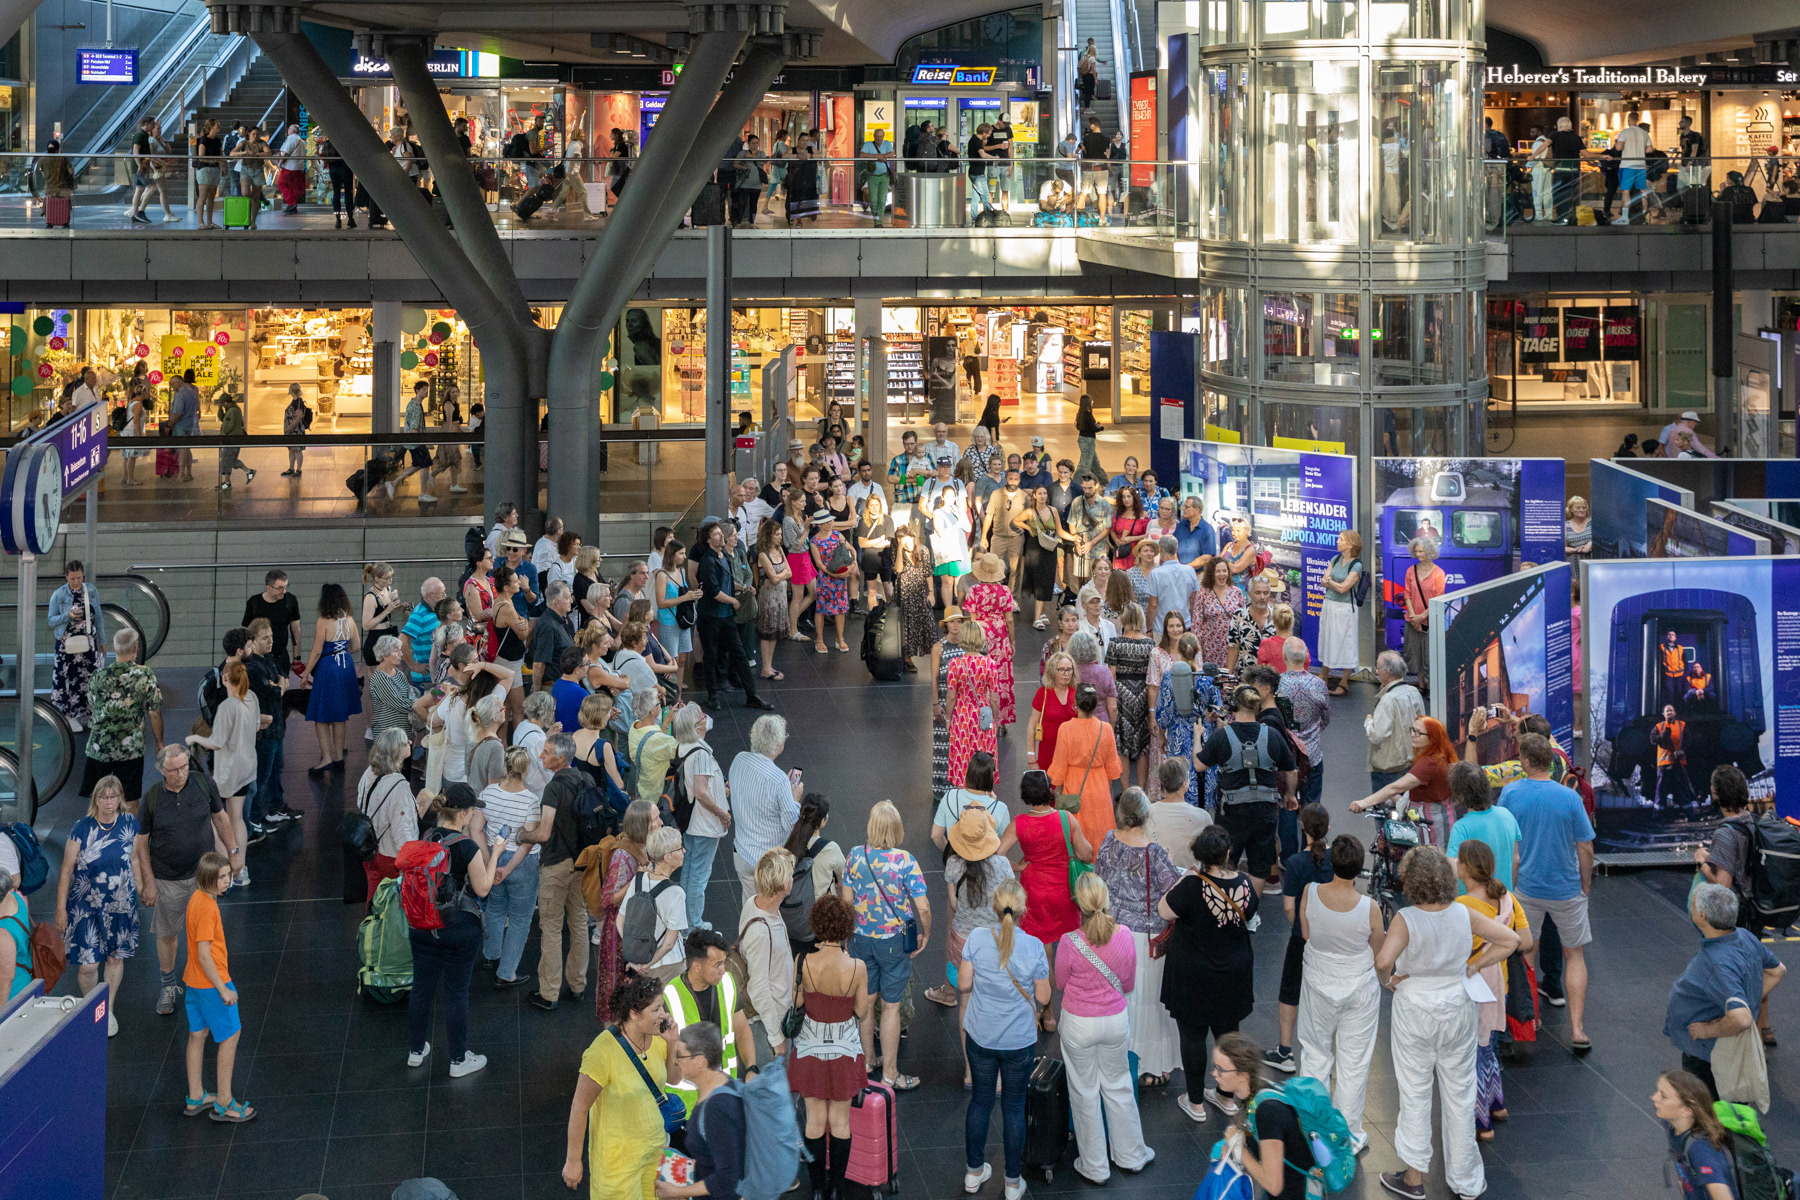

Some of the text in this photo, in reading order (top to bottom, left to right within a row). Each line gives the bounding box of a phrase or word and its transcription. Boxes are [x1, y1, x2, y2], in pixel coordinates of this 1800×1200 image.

[354, 56, 459, 73] disco ERLIN
[918, 69, 989, 82] Reise Bank
[1573, 67, 1652, 84] Traditional
[1656, 68, 1707, 86] Bakery
[1132, 110, 1152, 120] ABWEHR
[1534, 325, 1547, 337] 10
[1566, 328, 1589, 337] ODER
[1606, 326, 1632, 335] MUSS
[1522, 337, 1559, 352] TAGE
[1605, 334, 1638, 347] RAUS
[1552, 371, 1566, 381] 70
[71, 417, 86, 450] 11-16
[1198, 458, 1204, 471] 6
[1280, 499, 1347, 518] LEBENSADER
[1280, 514, 1307, 528] BAHN
[1309, 517, 1347, 531] ЗАЛІЗНА
[1280, 530, 1340, 546] ДОРОГА ЖИТТ
[1314, 584, 1326, 593] Krieg
